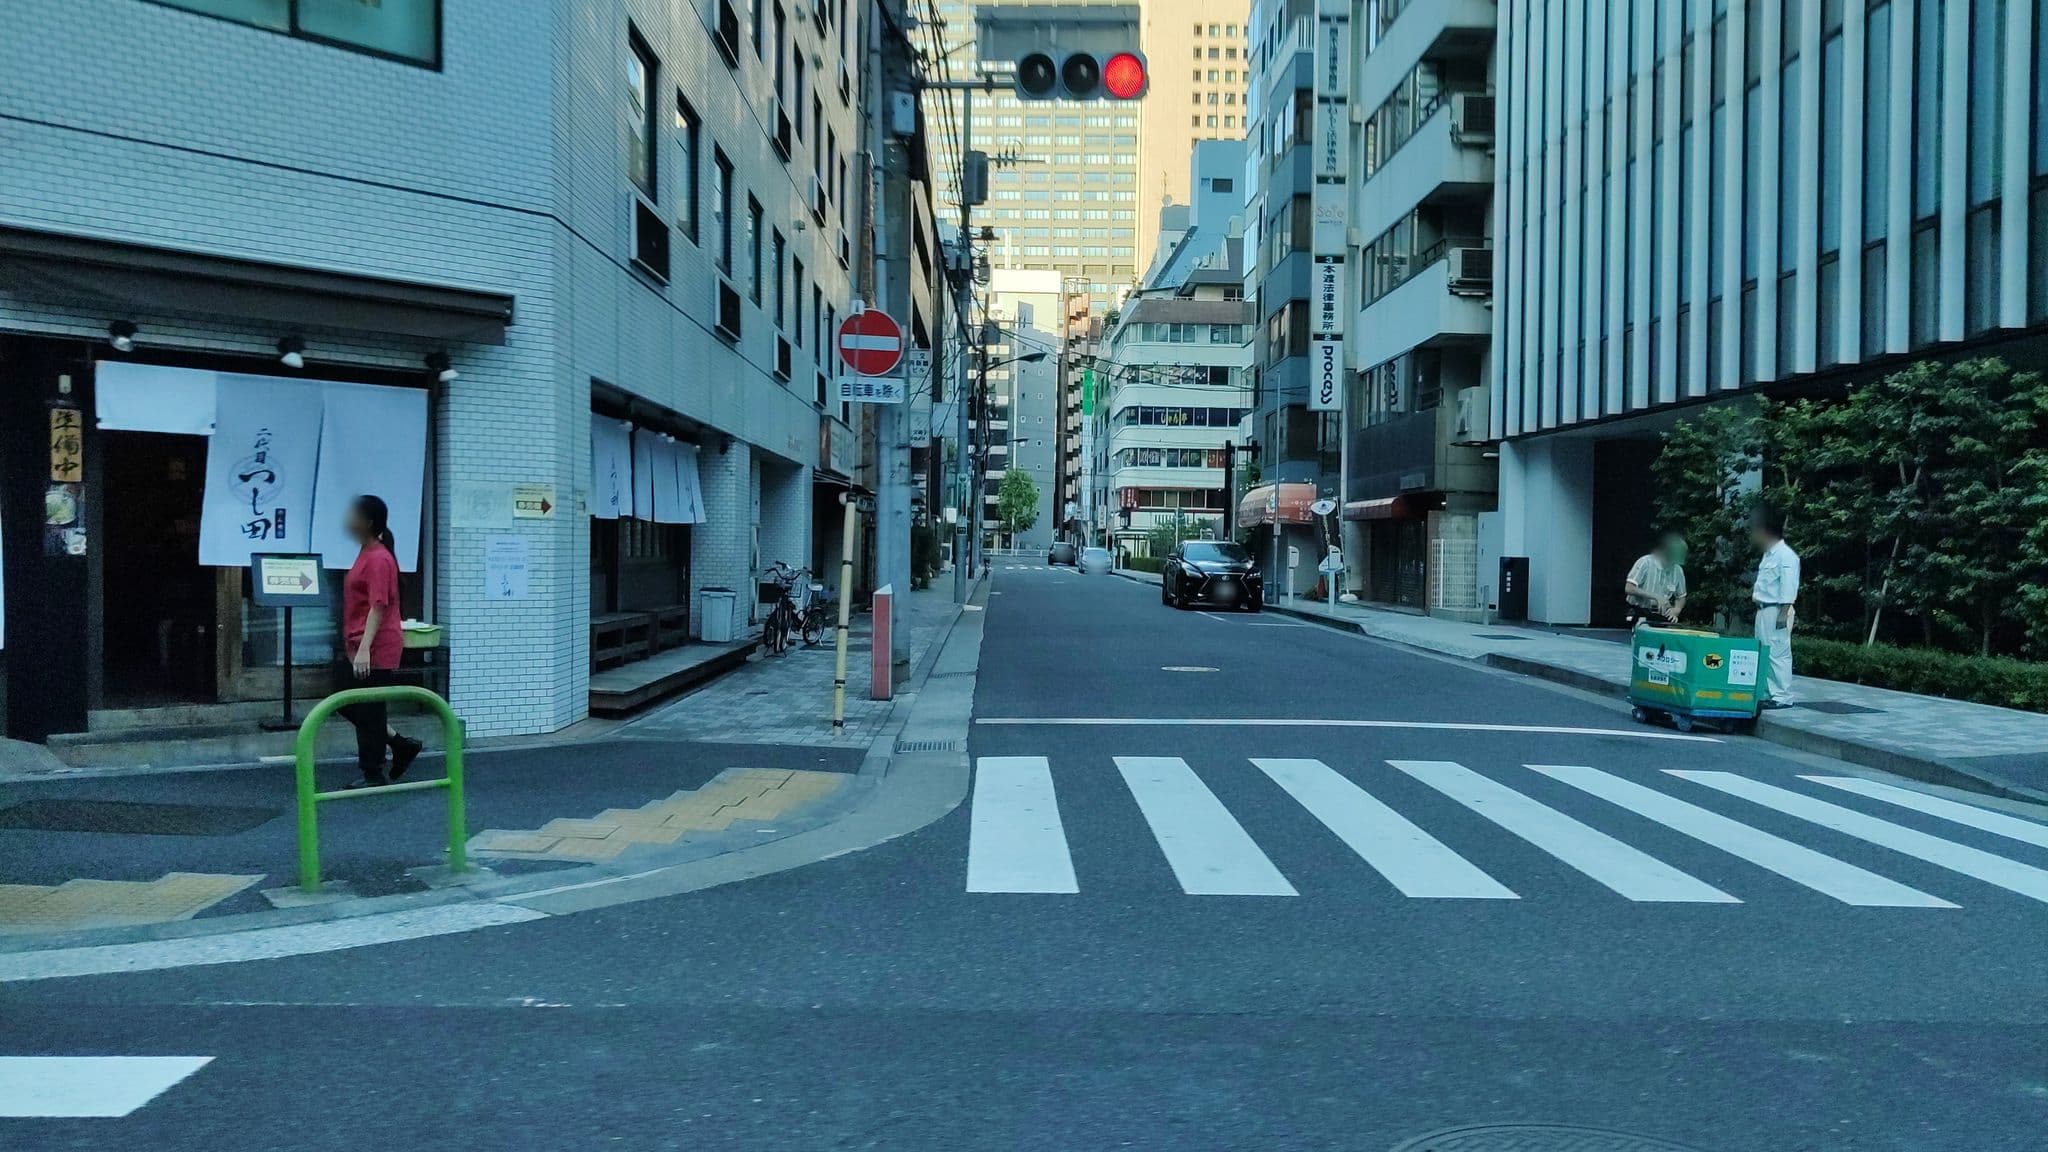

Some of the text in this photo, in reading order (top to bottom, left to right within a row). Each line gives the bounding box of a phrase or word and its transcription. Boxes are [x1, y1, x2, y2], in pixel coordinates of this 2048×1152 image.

[1322, 265, 1335, 331] 本渡法律事務所
[841, 383, 900, 398] 自転車を除く
[1320, 345, 1334, 405] process
[54, 411, 80, 477] 準備中
